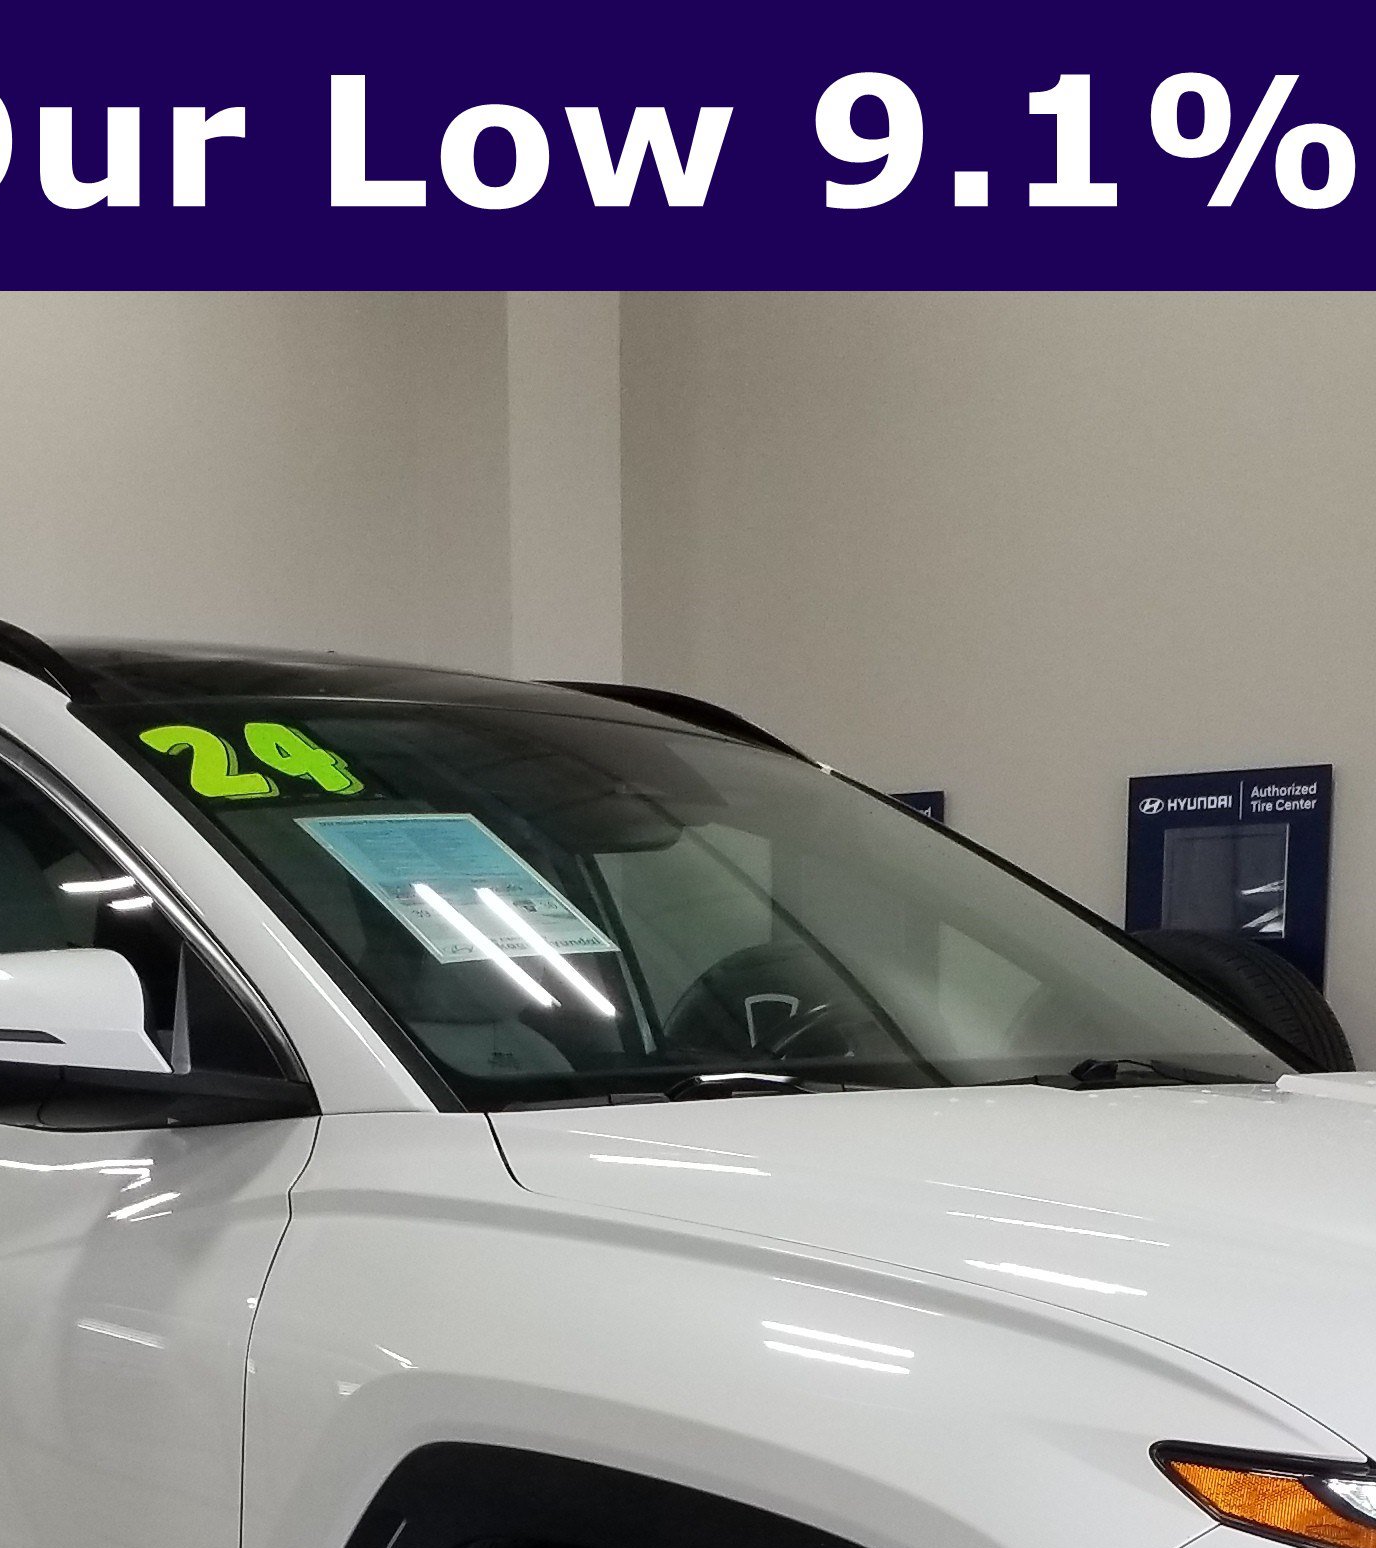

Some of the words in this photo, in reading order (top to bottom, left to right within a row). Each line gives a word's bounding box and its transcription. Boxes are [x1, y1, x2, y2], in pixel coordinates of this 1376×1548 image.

[138, 722, 365, 800] 24
[1250, 781, 1318, 798] Authorized
[1167, 795, 1233, 812] HYUNDAI
[1250, 800, 1273, 813] Tire
[1275, 798, 1317, 812] Center
